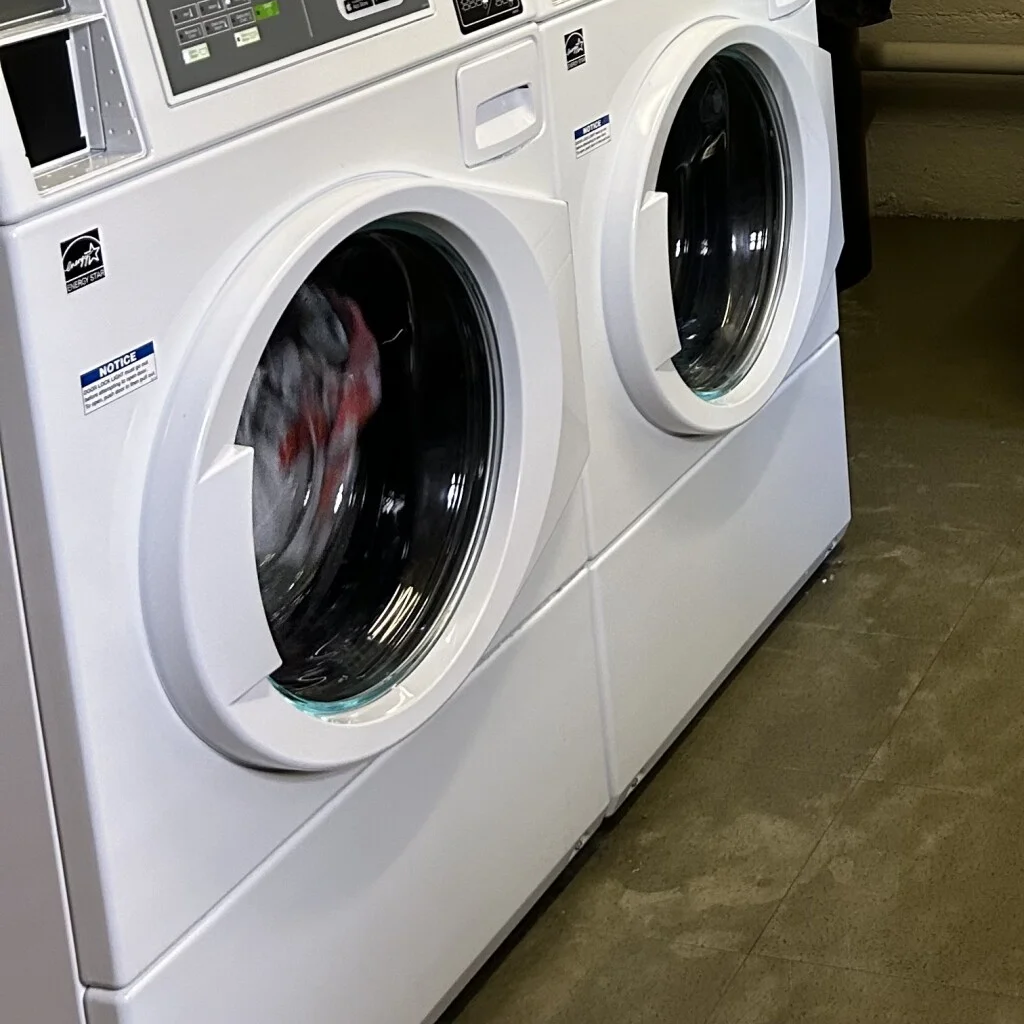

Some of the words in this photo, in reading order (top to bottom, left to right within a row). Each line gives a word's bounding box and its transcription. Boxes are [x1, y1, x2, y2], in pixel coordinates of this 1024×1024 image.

[66, 276, 89, 292] ENERGY
[99, 351, 138, 378] NOTICE
[98, 378, 110, 388] LOCK
